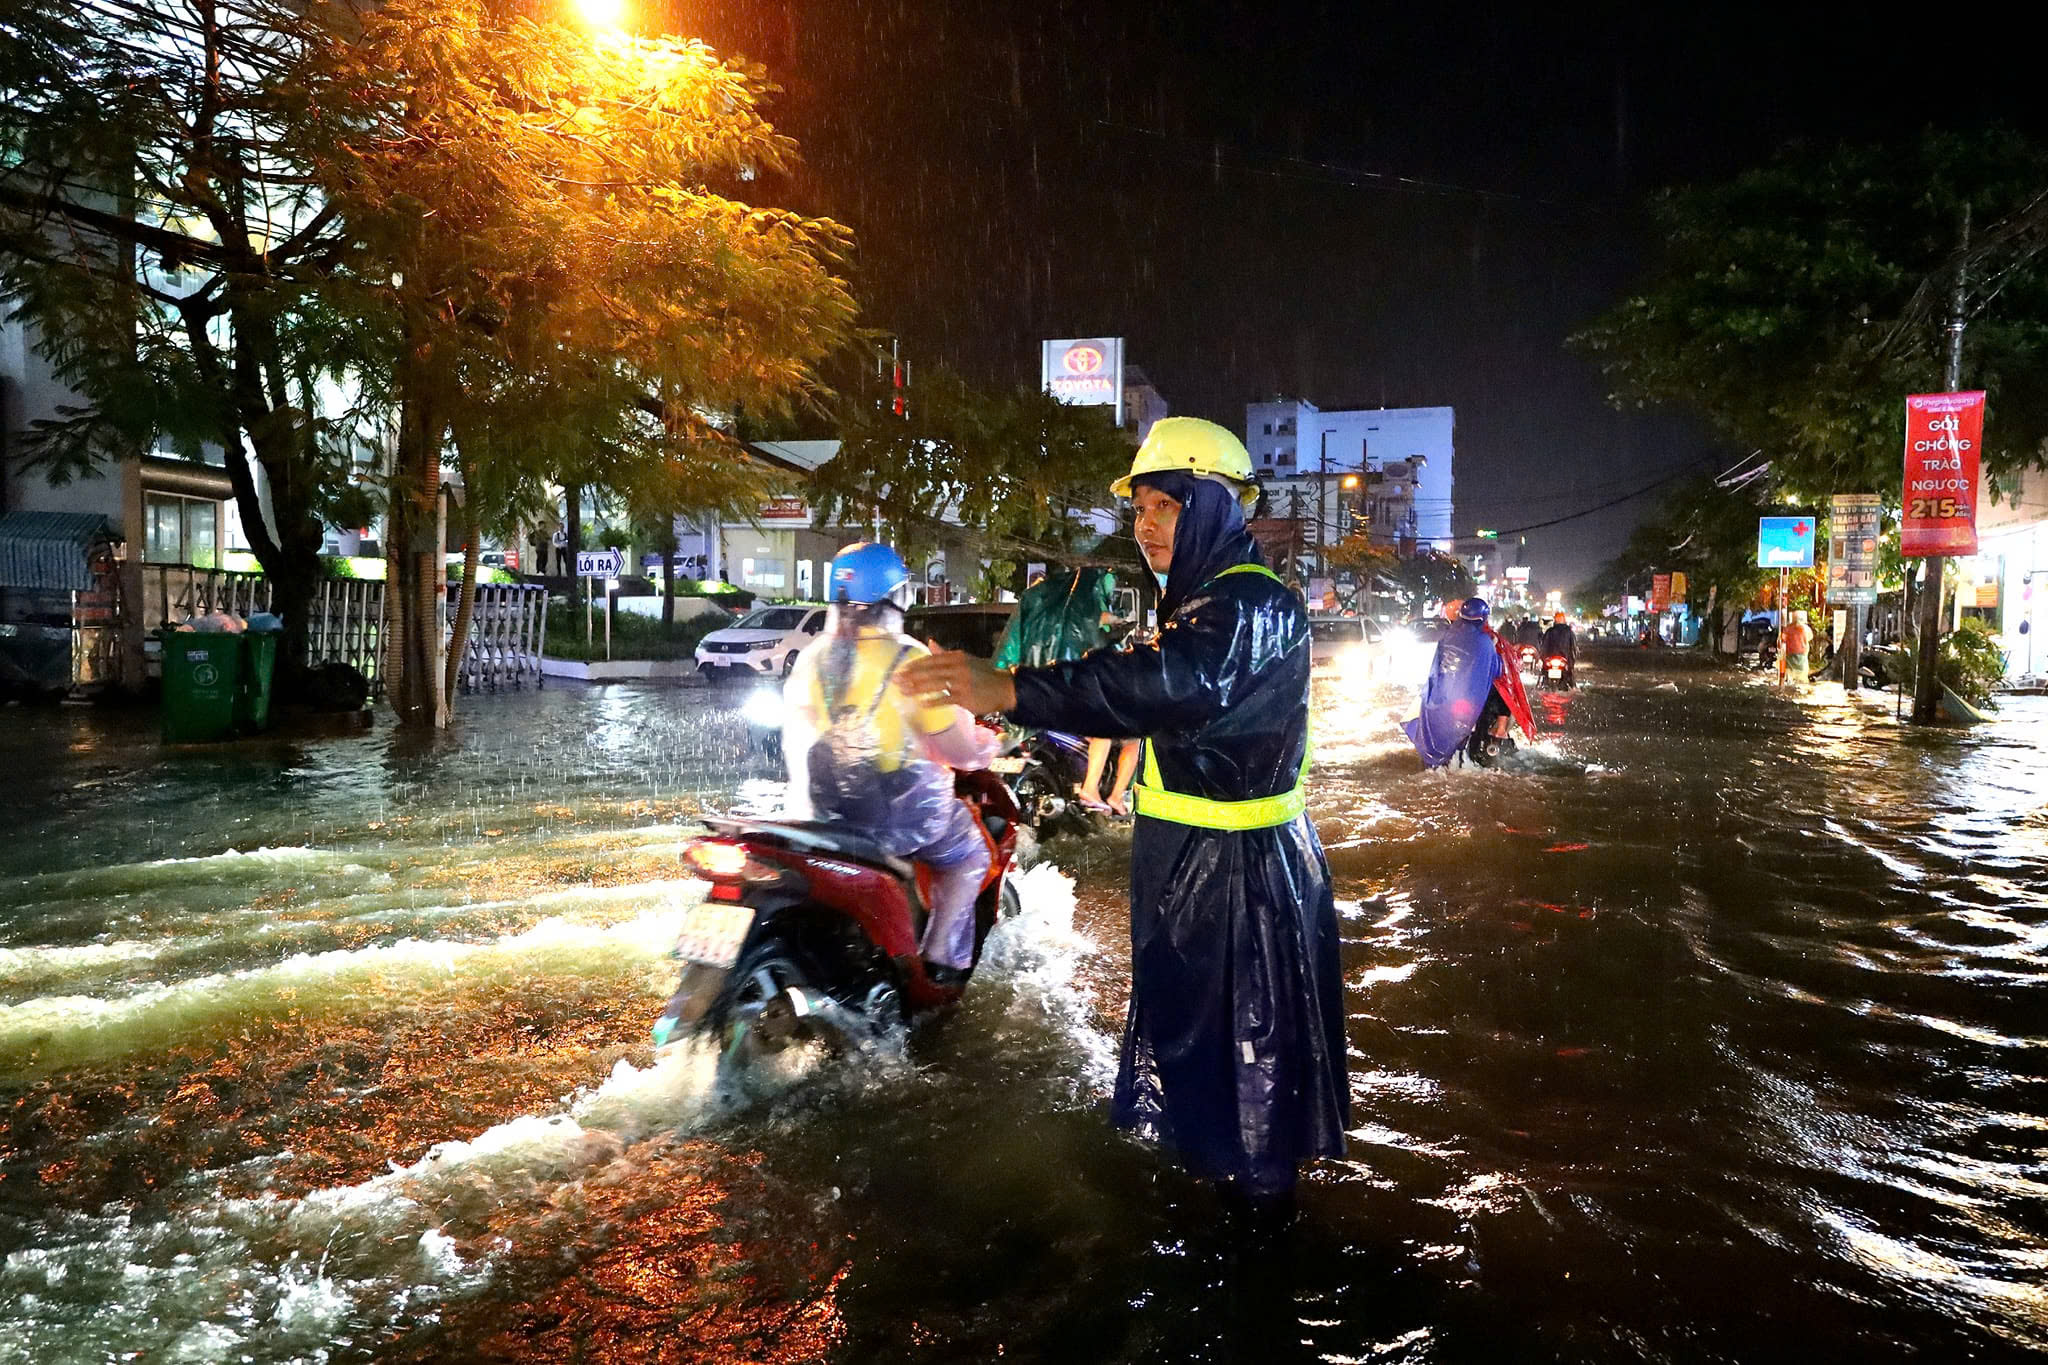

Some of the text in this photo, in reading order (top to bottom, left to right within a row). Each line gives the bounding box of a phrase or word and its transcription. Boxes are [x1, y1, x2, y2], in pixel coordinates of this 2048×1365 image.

[1053, 378, 1113, 393] TOYOTA
[1922, 457, 1961, 471] TRÀO
[1912, 478, 1970, 492] NGƯỢC
[1910, 498, 1956, 519] 215
[579, 555, 612, 572] LỐI RA
